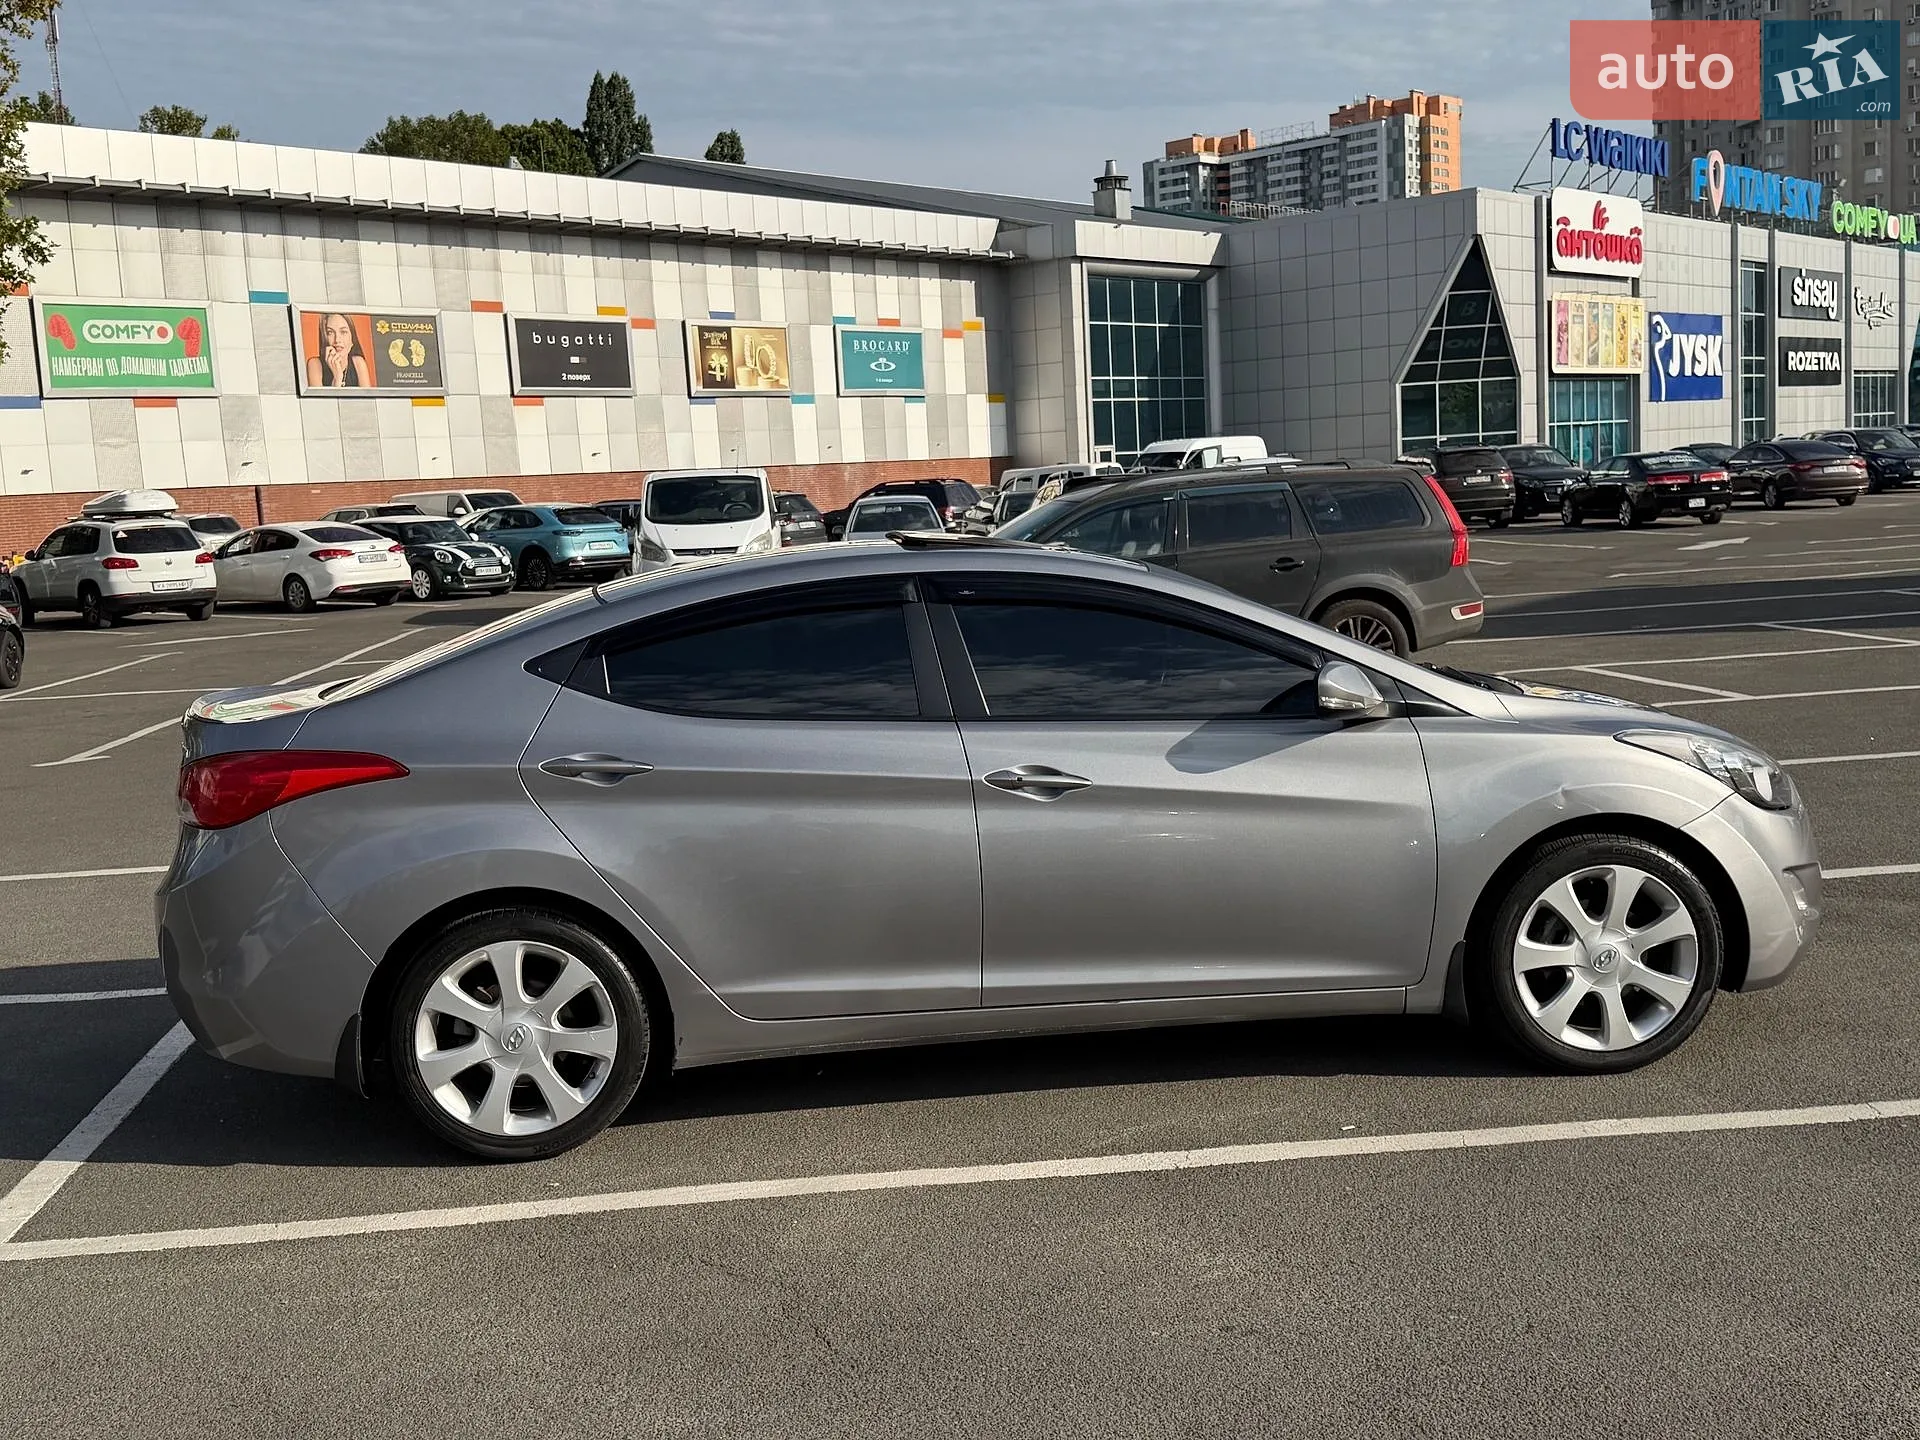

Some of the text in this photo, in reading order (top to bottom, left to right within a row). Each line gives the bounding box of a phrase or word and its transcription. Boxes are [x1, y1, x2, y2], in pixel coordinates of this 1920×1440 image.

[1552, 117, 1583, 161] LC
[1783, 176, 1822, 222] SKY
[1831, 200, 1888, 240] COMFY
[1793, 269, 1838, 320] sinsay
[87, 323, 155, 340] COMFY
[532, 331, 612, 348] bugatti
[853, 339, 909, 351] BROCARD
[1668, 334, 1723, 377] JYSK
[52, 355, 209, 377] НАМБЕРВАН ПО ДОМАШНІМ ГАДЖЕТАМ
[1787, 351, 1841, 372] ROZETKA
[561, 373, 567, 381] 2
